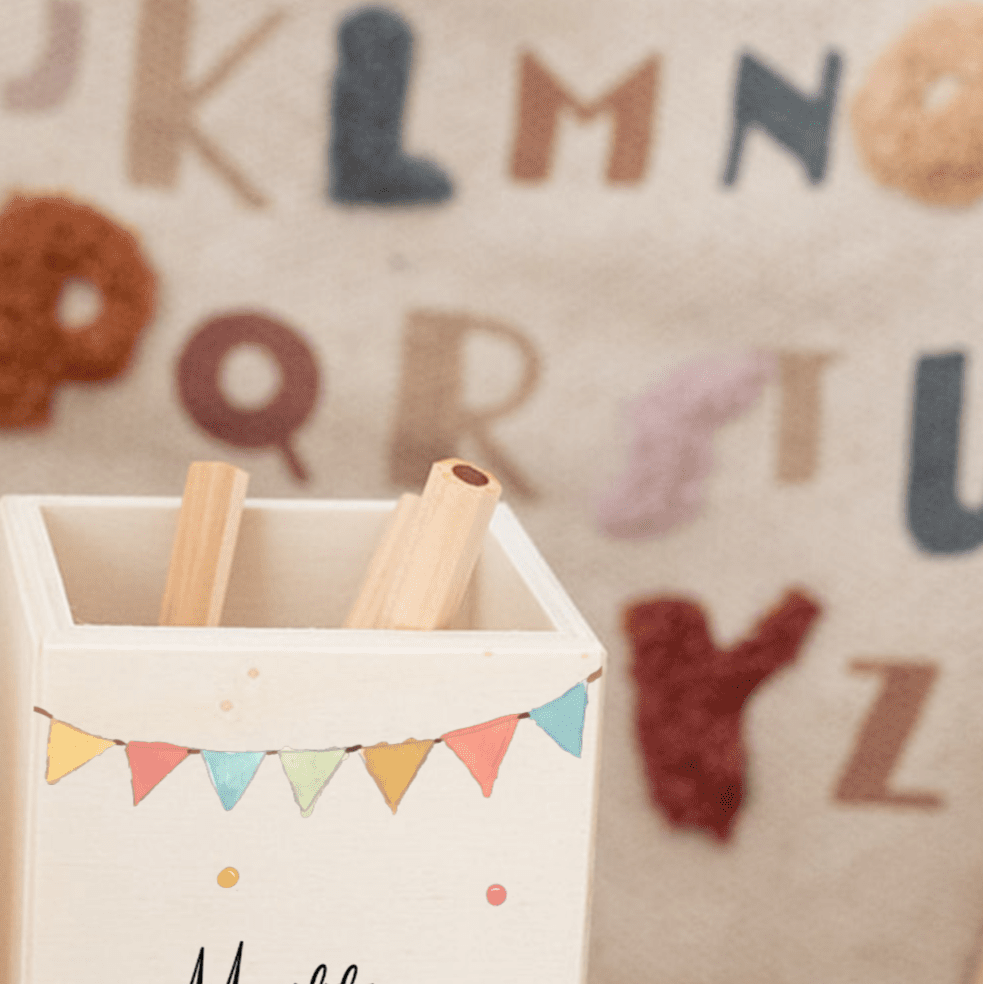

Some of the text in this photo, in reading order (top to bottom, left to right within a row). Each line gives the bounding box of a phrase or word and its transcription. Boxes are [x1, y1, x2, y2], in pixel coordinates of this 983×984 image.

[125, 0, 287, 209] K
[327, 3, 454, 206] L
[506, 48, 662, 187] M
[720, 46, 841, 190] N
[850, 3, 983, 208] O
[175, 308, 324, 485] Q
[386, 308, 542, 500] R
[754, 348, 842, 484] T
[622, 590, 945, 845] Y Z
